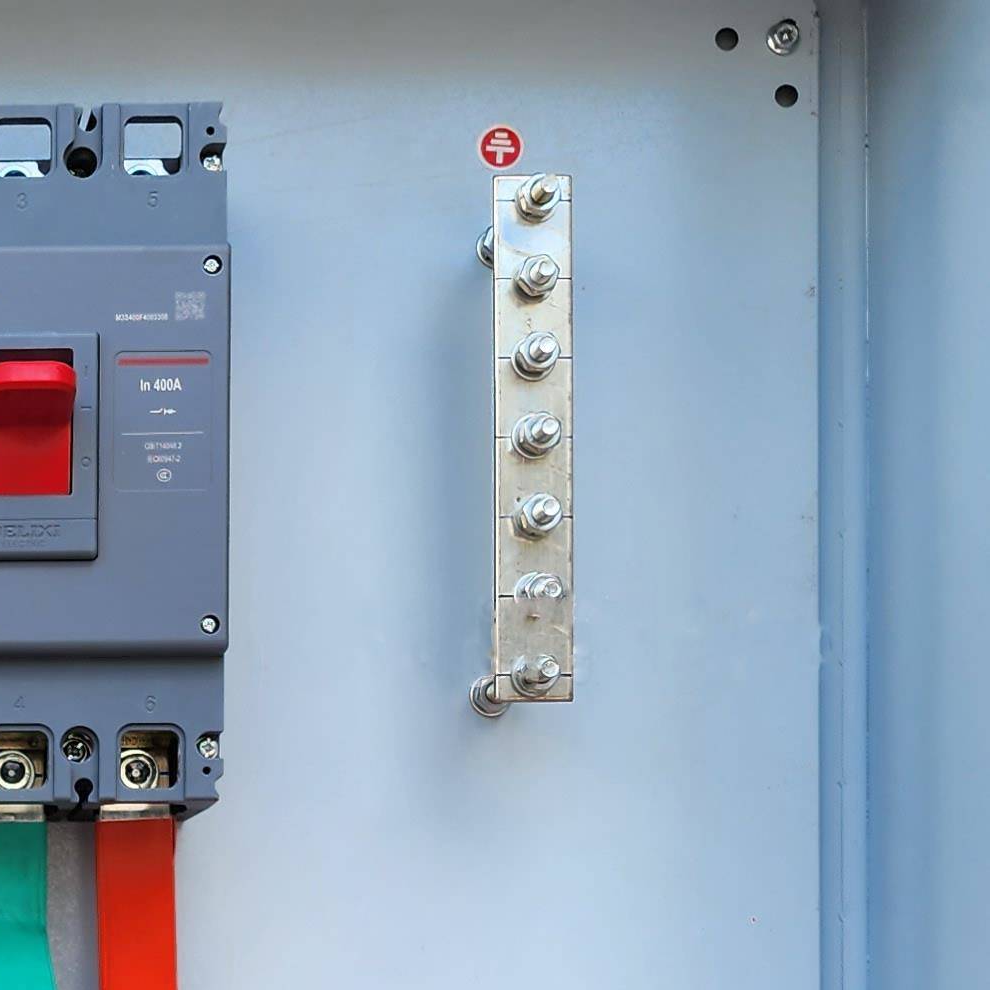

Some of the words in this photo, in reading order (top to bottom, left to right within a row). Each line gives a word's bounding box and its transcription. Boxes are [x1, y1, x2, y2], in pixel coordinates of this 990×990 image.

[16, 191, 29, 210] 3
[147, 190, 159, 208] 5
[140, 379, 151, 391] In
[153, 378, 182, 391] 400A
[13, 696, 26, 709] 4
[145, 695, 156, 712] 6
